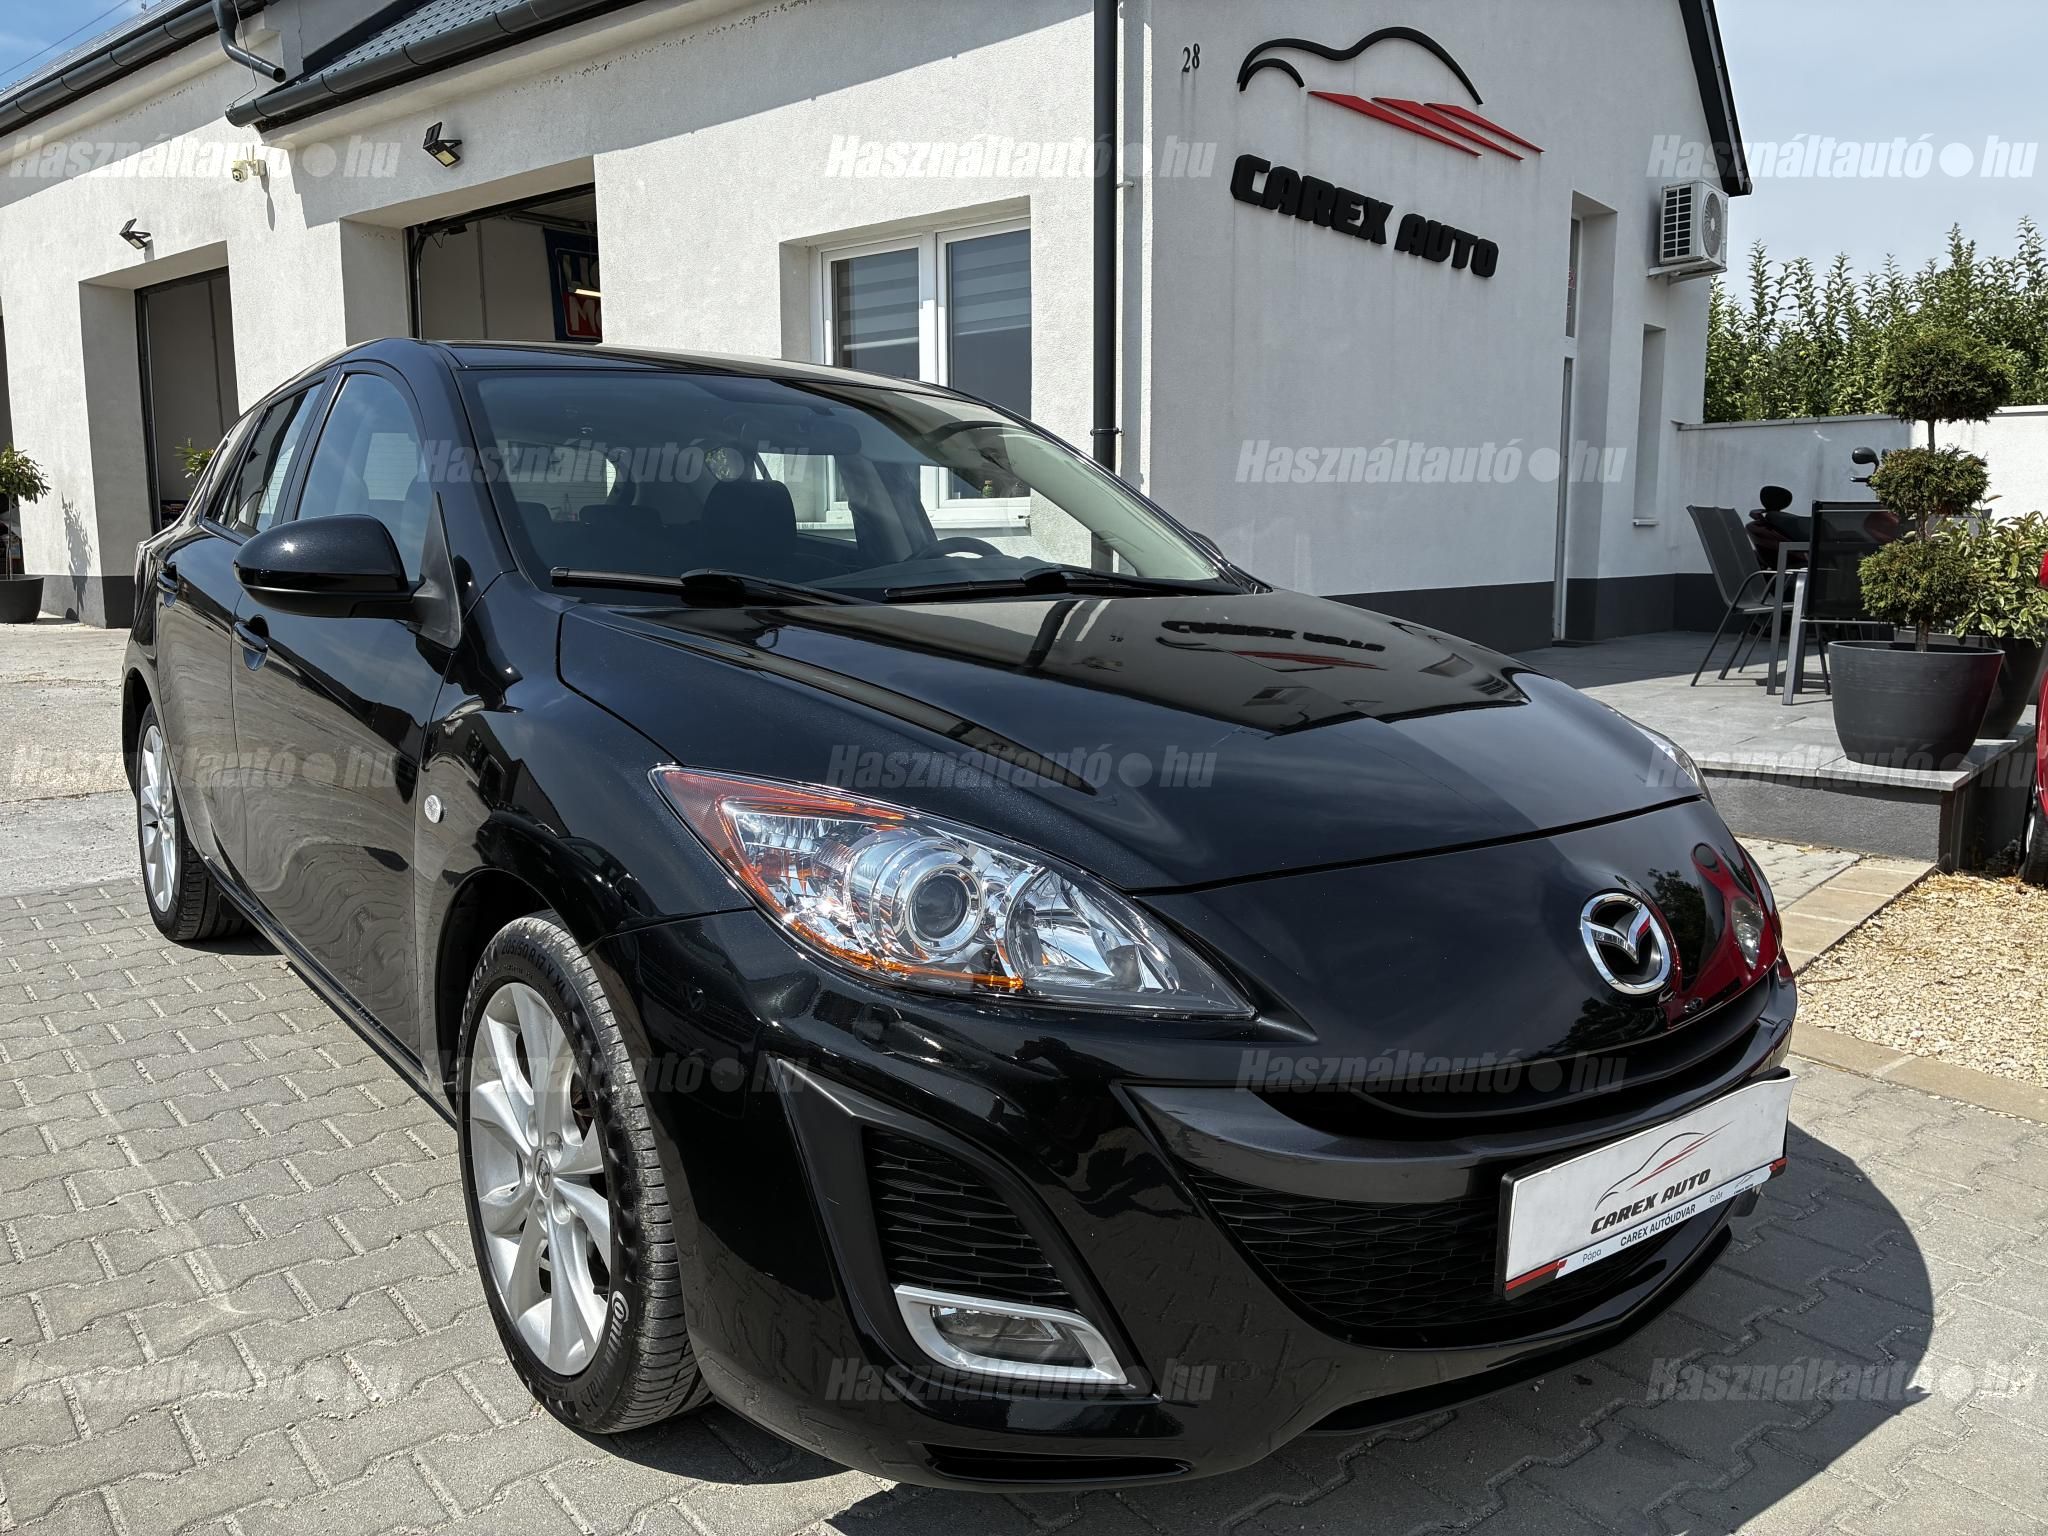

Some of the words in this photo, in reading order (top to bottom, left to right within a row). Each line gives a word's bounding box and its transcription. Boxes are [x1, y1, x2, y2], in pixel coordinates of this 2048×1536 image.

[1181, 42, 1200, 73] 28
[1230, 154, 1394, 245] CAREX
[1394, 213, 1499, 278] AUTO
[1590, 1193, 1659, 1235] CAREX
[1661, 1168, 1711, 1204] AUTO
[1620, 1226, 1648, 1247] CAREX
[1649, 1203, 1696, 1234] AUTÓUDVAR
